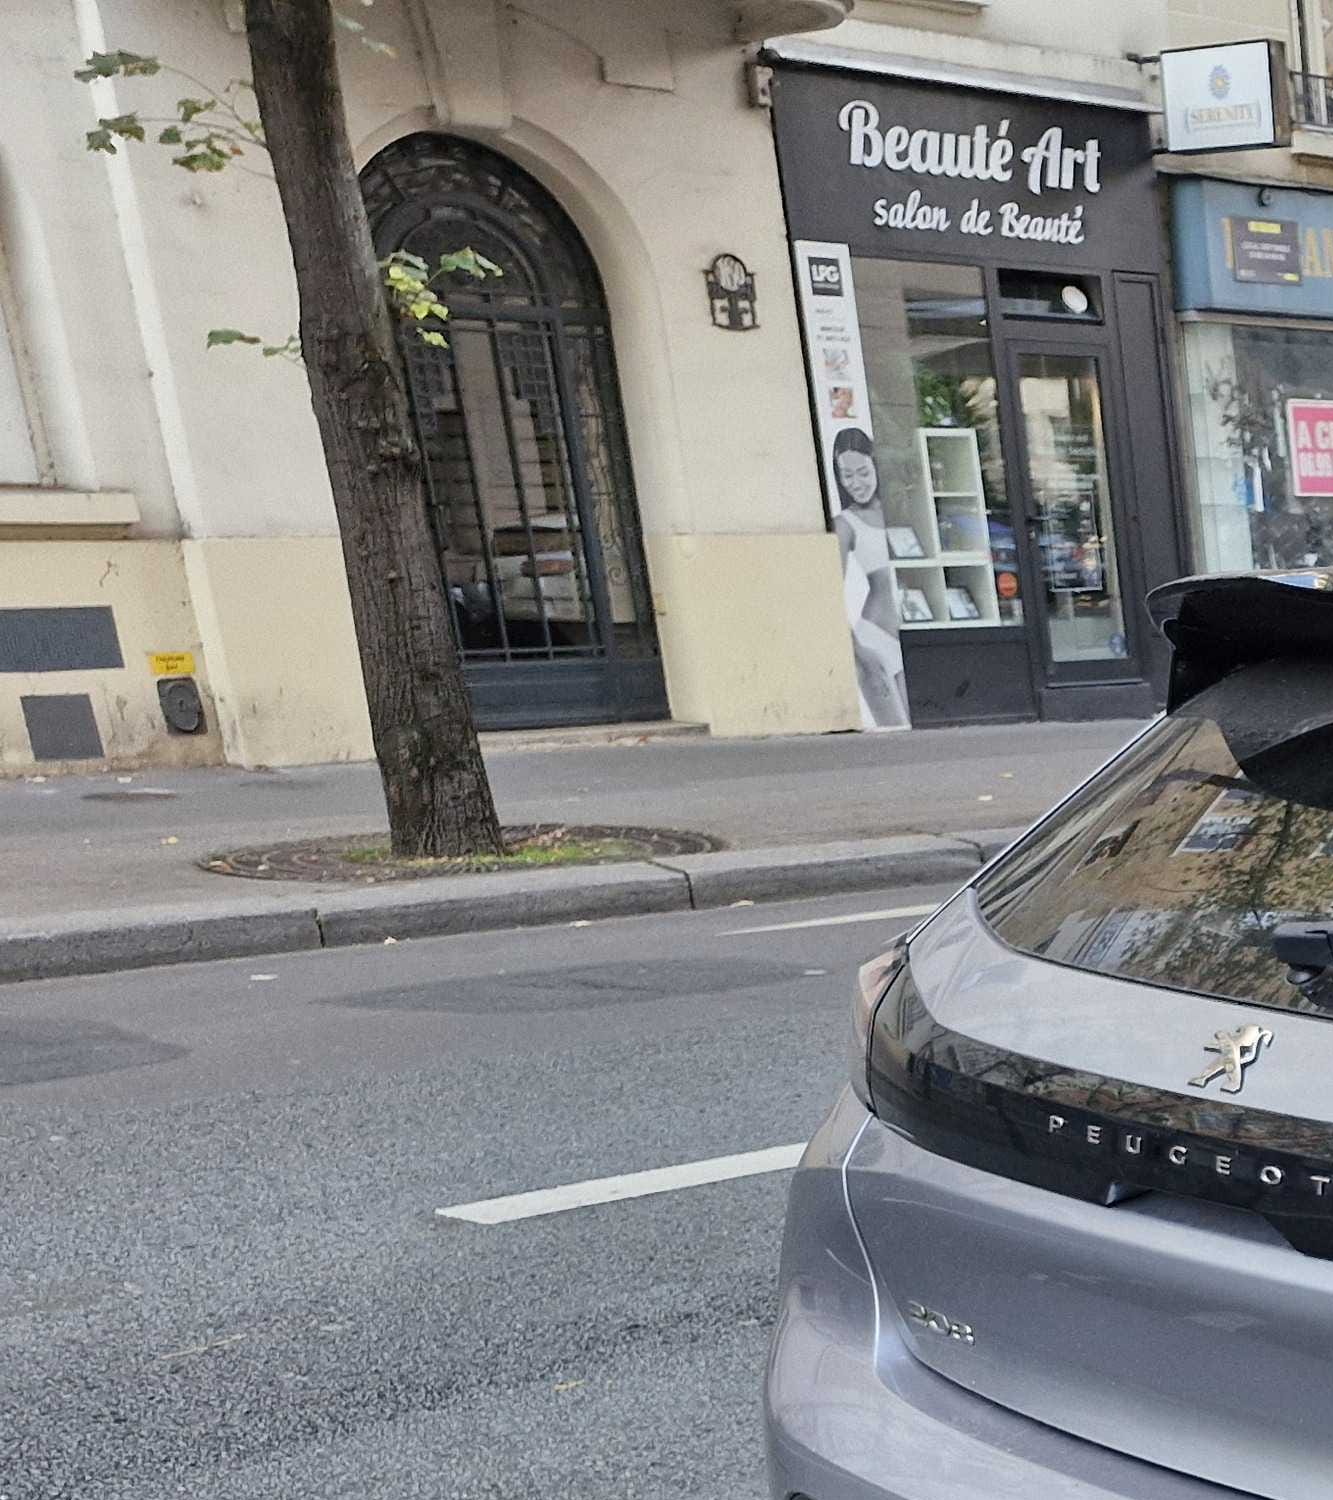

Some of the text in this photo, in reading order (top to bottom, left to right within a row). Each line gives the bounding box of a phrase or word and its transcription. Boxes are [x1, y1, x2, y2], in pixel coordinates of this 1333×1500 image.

[838, 99, 1101, 196] Beauté Art
[873, 189, 1085, 244] salon de Beauté
[1296, 421, 1312, 449] A
[1049, 1114, 1331, 1197] PEUGEOT
